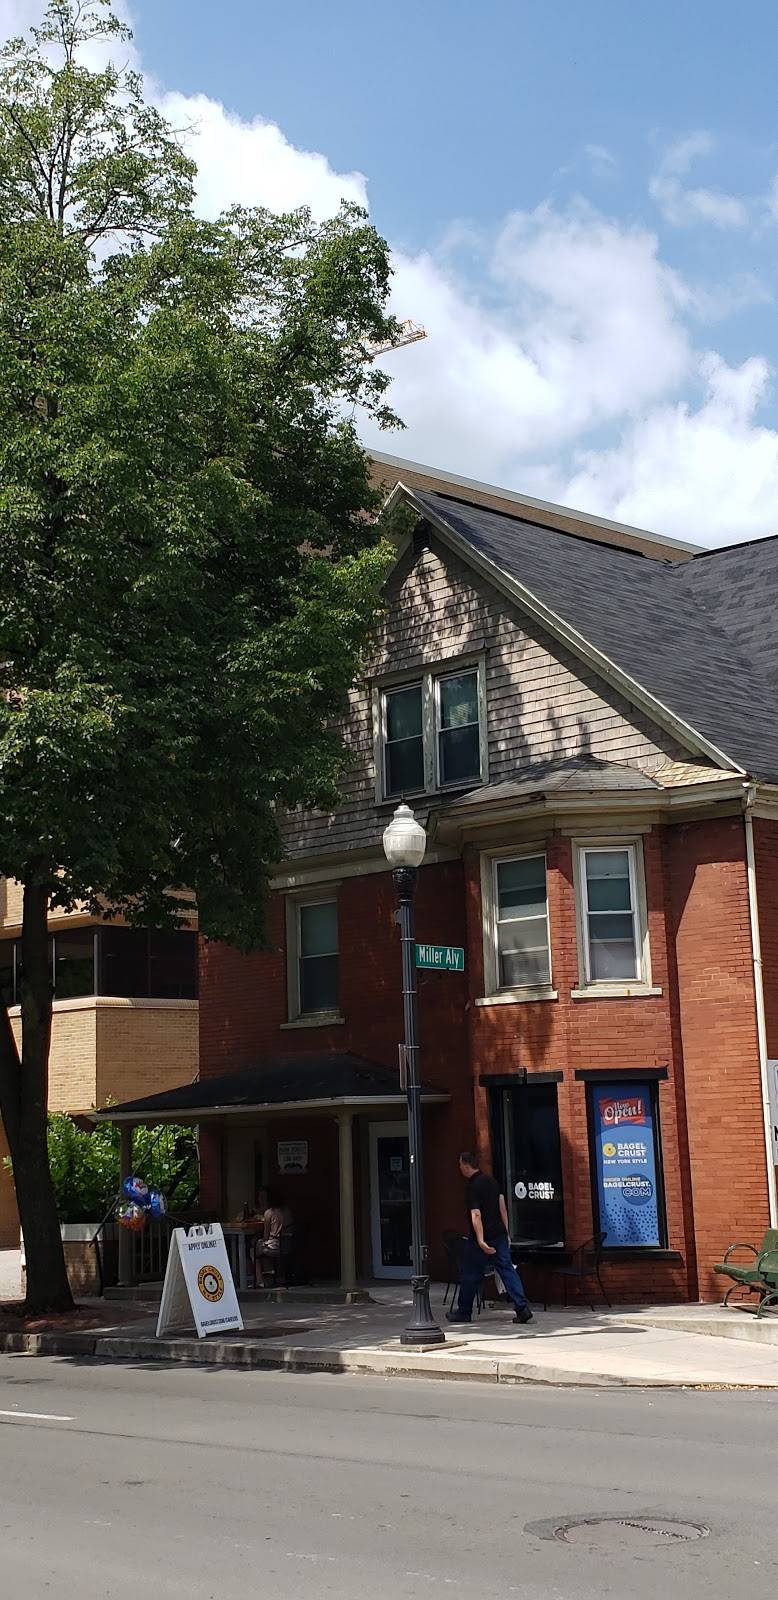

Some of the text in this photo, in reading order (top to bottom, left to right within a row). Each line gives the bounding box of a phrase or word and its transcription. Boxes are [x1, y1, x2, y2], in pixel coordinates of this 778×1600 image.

[419, 946, 459, 968] Miller Aly
[604, 1100, 642, 1124] Open!
[528, 1182, 554, 1190] BAGEL
[528, 1191, 554, 1199] CRUST
[188, 1242, 200, 1250] APPLY
